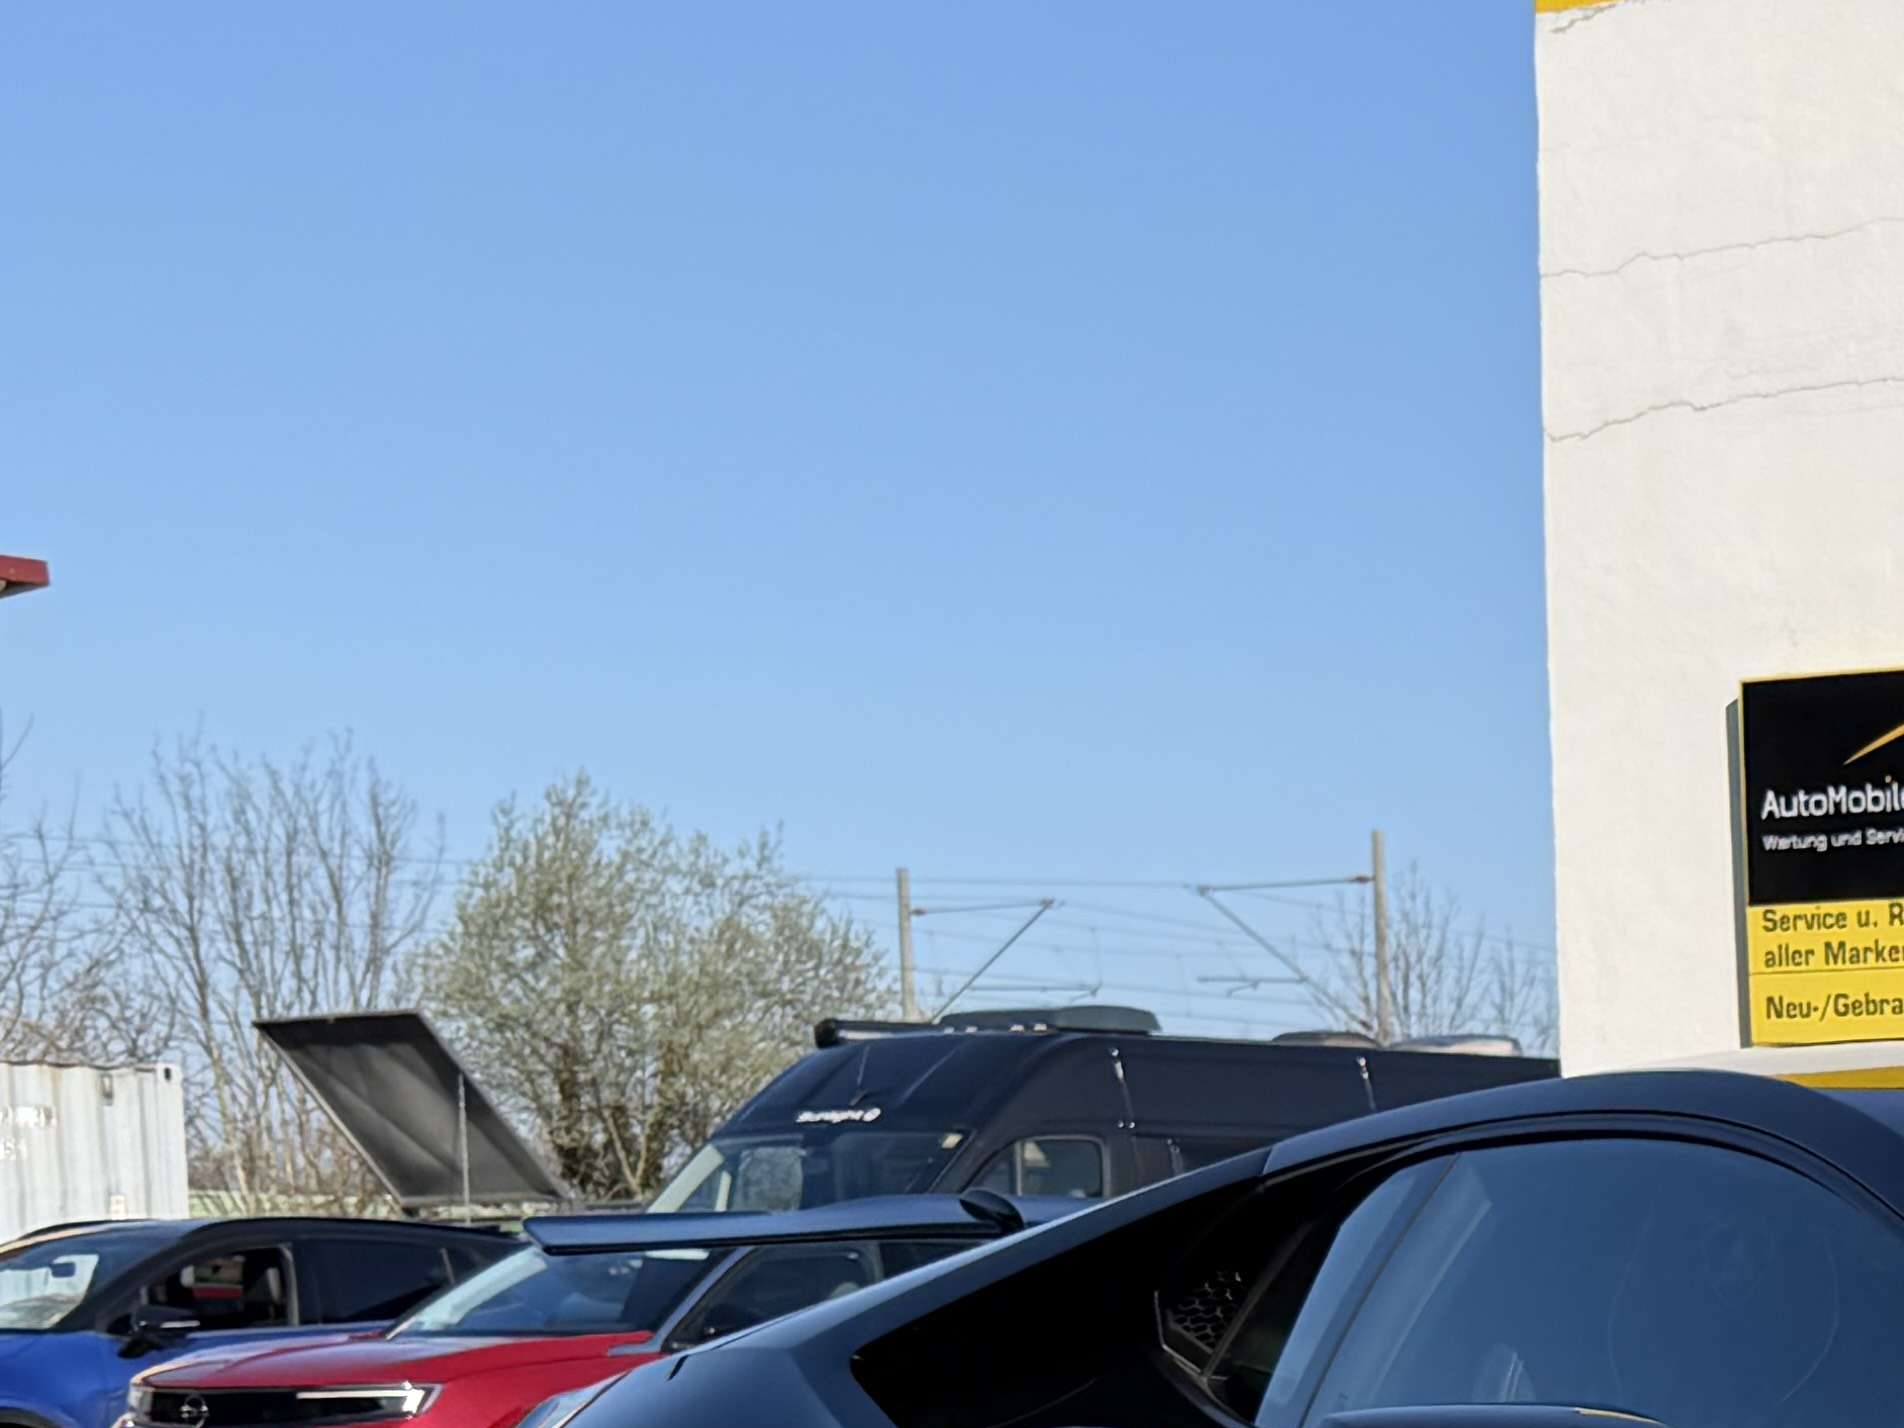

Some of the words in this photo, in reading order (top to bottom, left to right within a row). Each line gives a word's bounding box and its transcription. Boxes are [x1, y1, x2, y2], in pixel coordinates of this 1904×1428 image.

[1762, 834, 1828, 852] Wartung
[1831, 830, 1862, 847] und
[1762, 906, 1848, 932] Service
[1856, 909, 1878, 929] u.
[1764, 943, 1815, 968] aller
